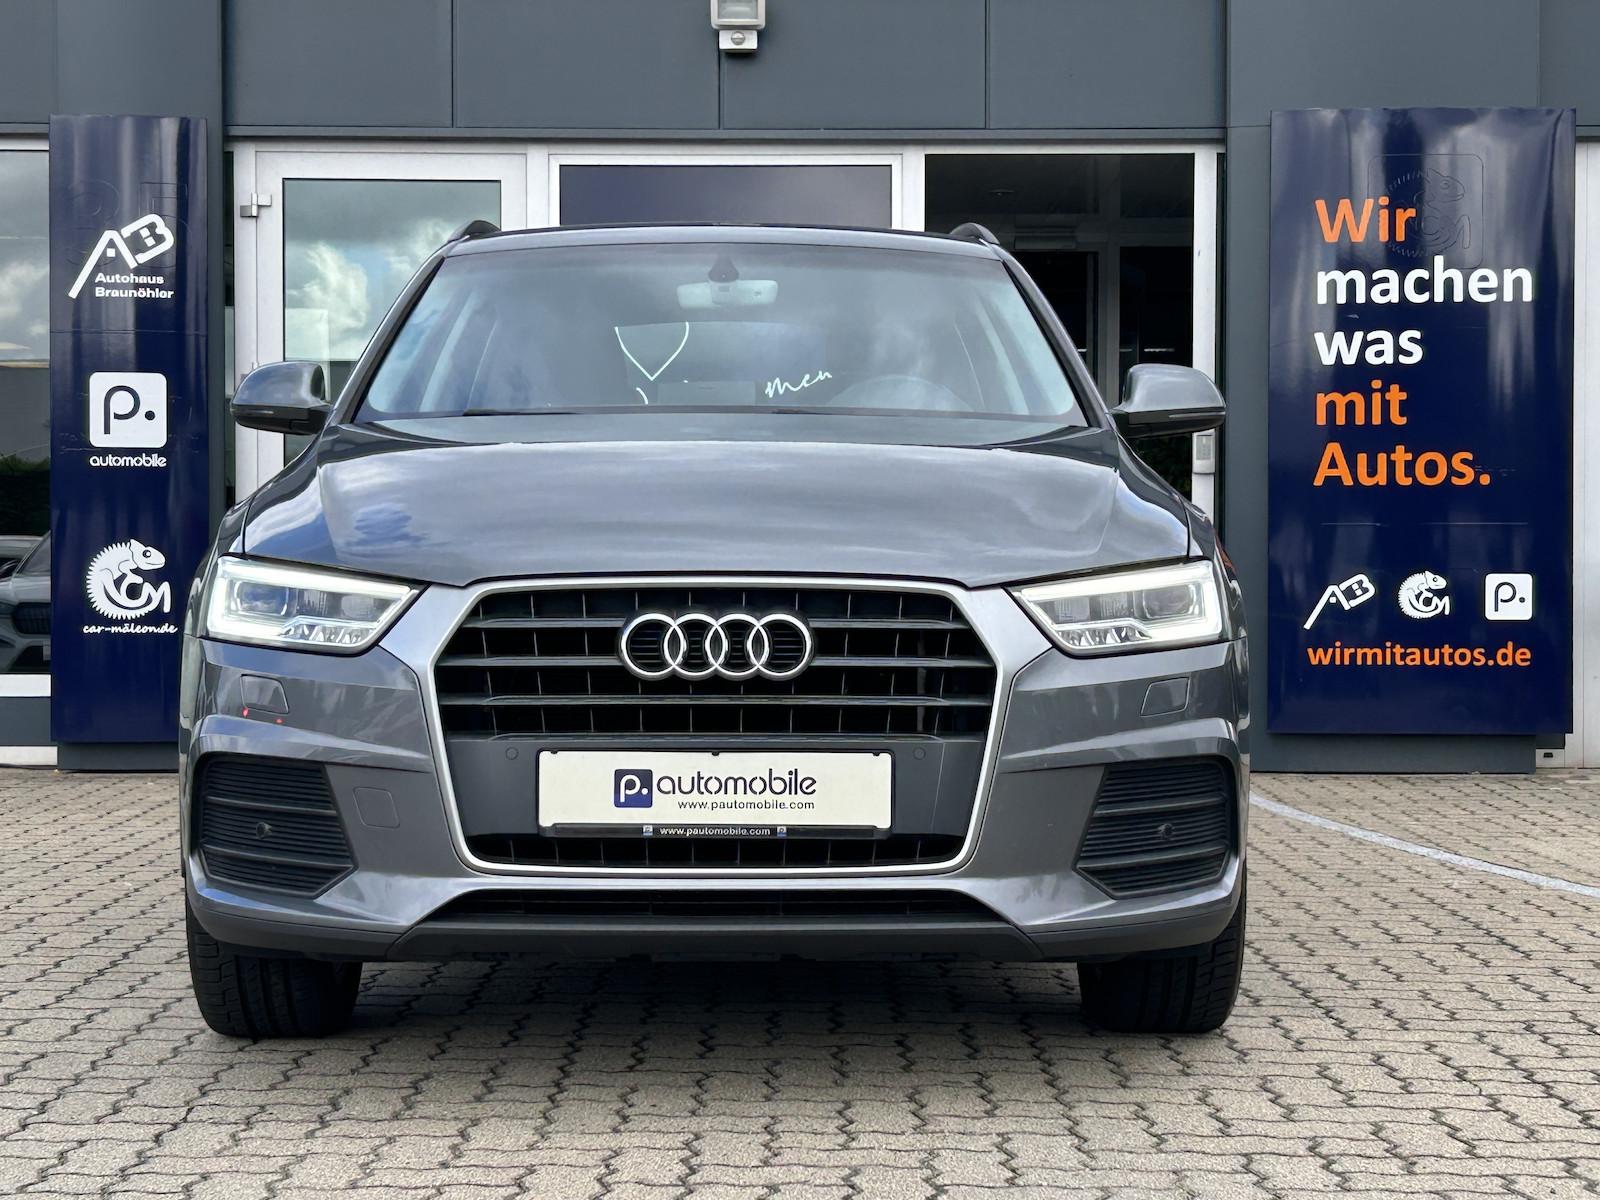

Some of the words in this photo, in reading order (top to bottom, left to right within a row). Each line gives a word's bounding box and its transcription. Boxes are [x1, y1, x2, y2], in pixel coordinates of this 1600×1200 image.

[1315, 196, 1416, 243] Wir
[95, 272, 164, 285] Autohaus
[1316, 255, 1533, 304] machen
[95, 287, 174, 299] Braunöhler
[1314, 328, 1424, 366] was
[1316, 379, 1407, 426] mit
[89, 453, 167, 467] automobile
[1313, 442, 1490, 487] Autos.
[1307, 641, 1532, 666] wirmitautos.de
[656, 768, 817, 795] automobile
[677, 800, 815, 811] www.pautomobile.com
[659, 825, 771, 837] www.pautomobile.com
